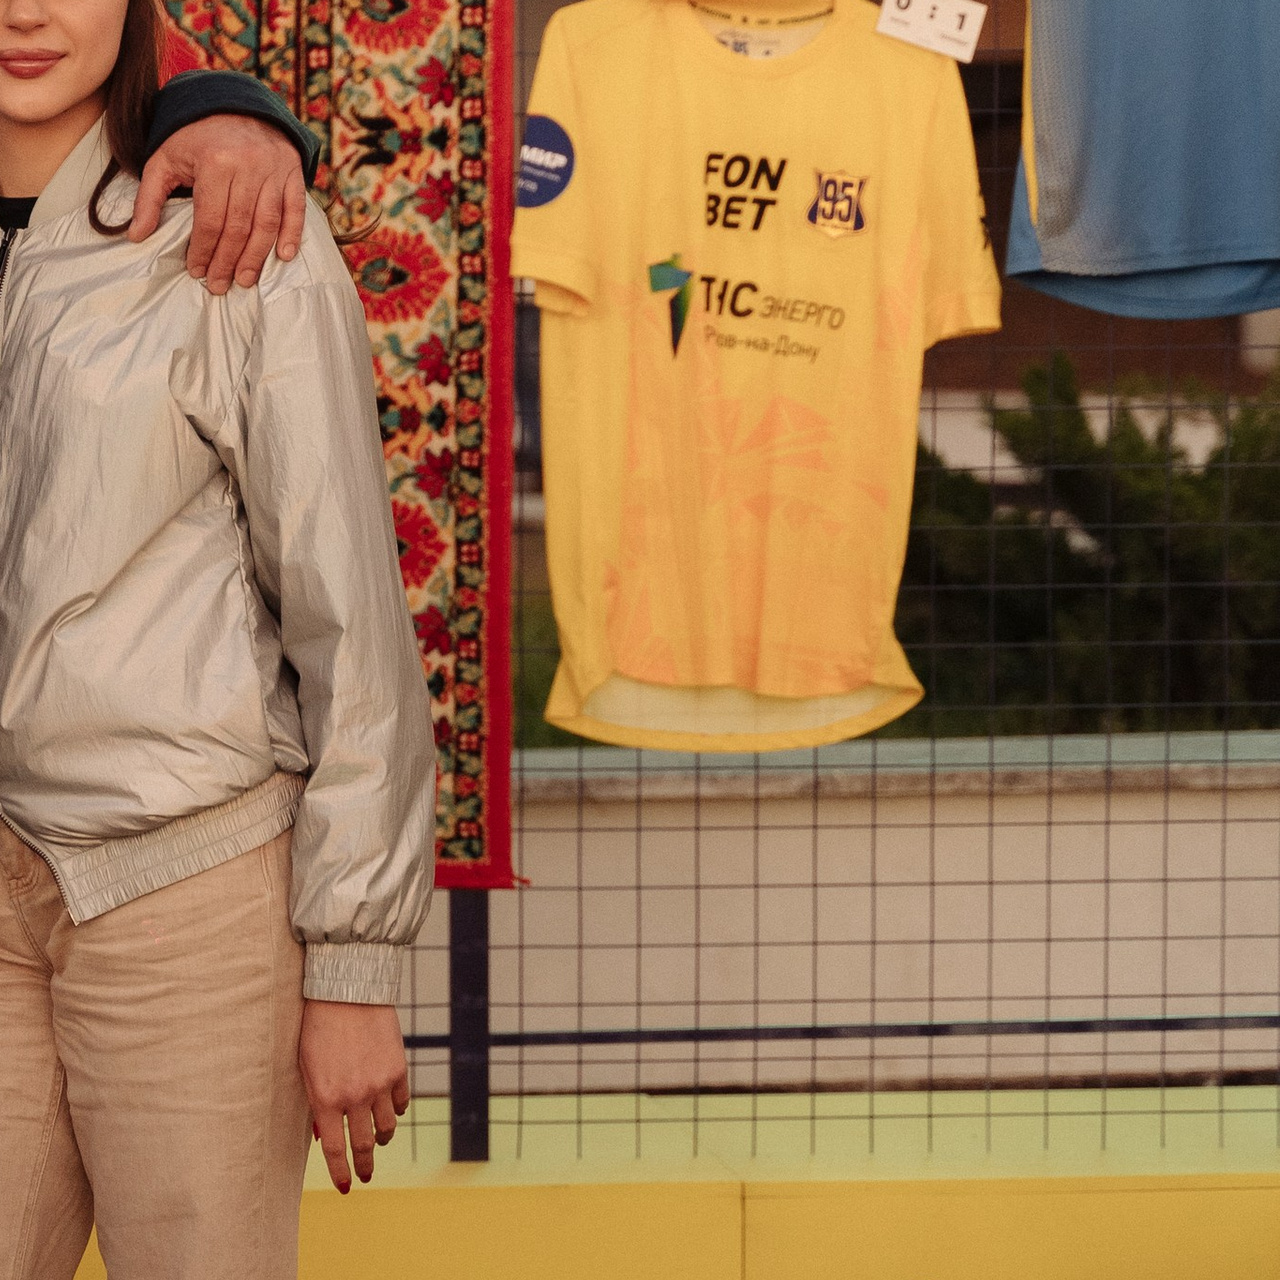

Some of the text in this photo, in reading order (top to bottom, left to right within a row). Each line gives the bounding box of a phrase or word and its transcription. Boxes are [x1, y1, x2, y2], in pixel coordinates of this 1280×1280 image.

[703, 152, 788, 192] FON
[706, 194, 778, 231] BET
[821, 178, 854, 223] 95
